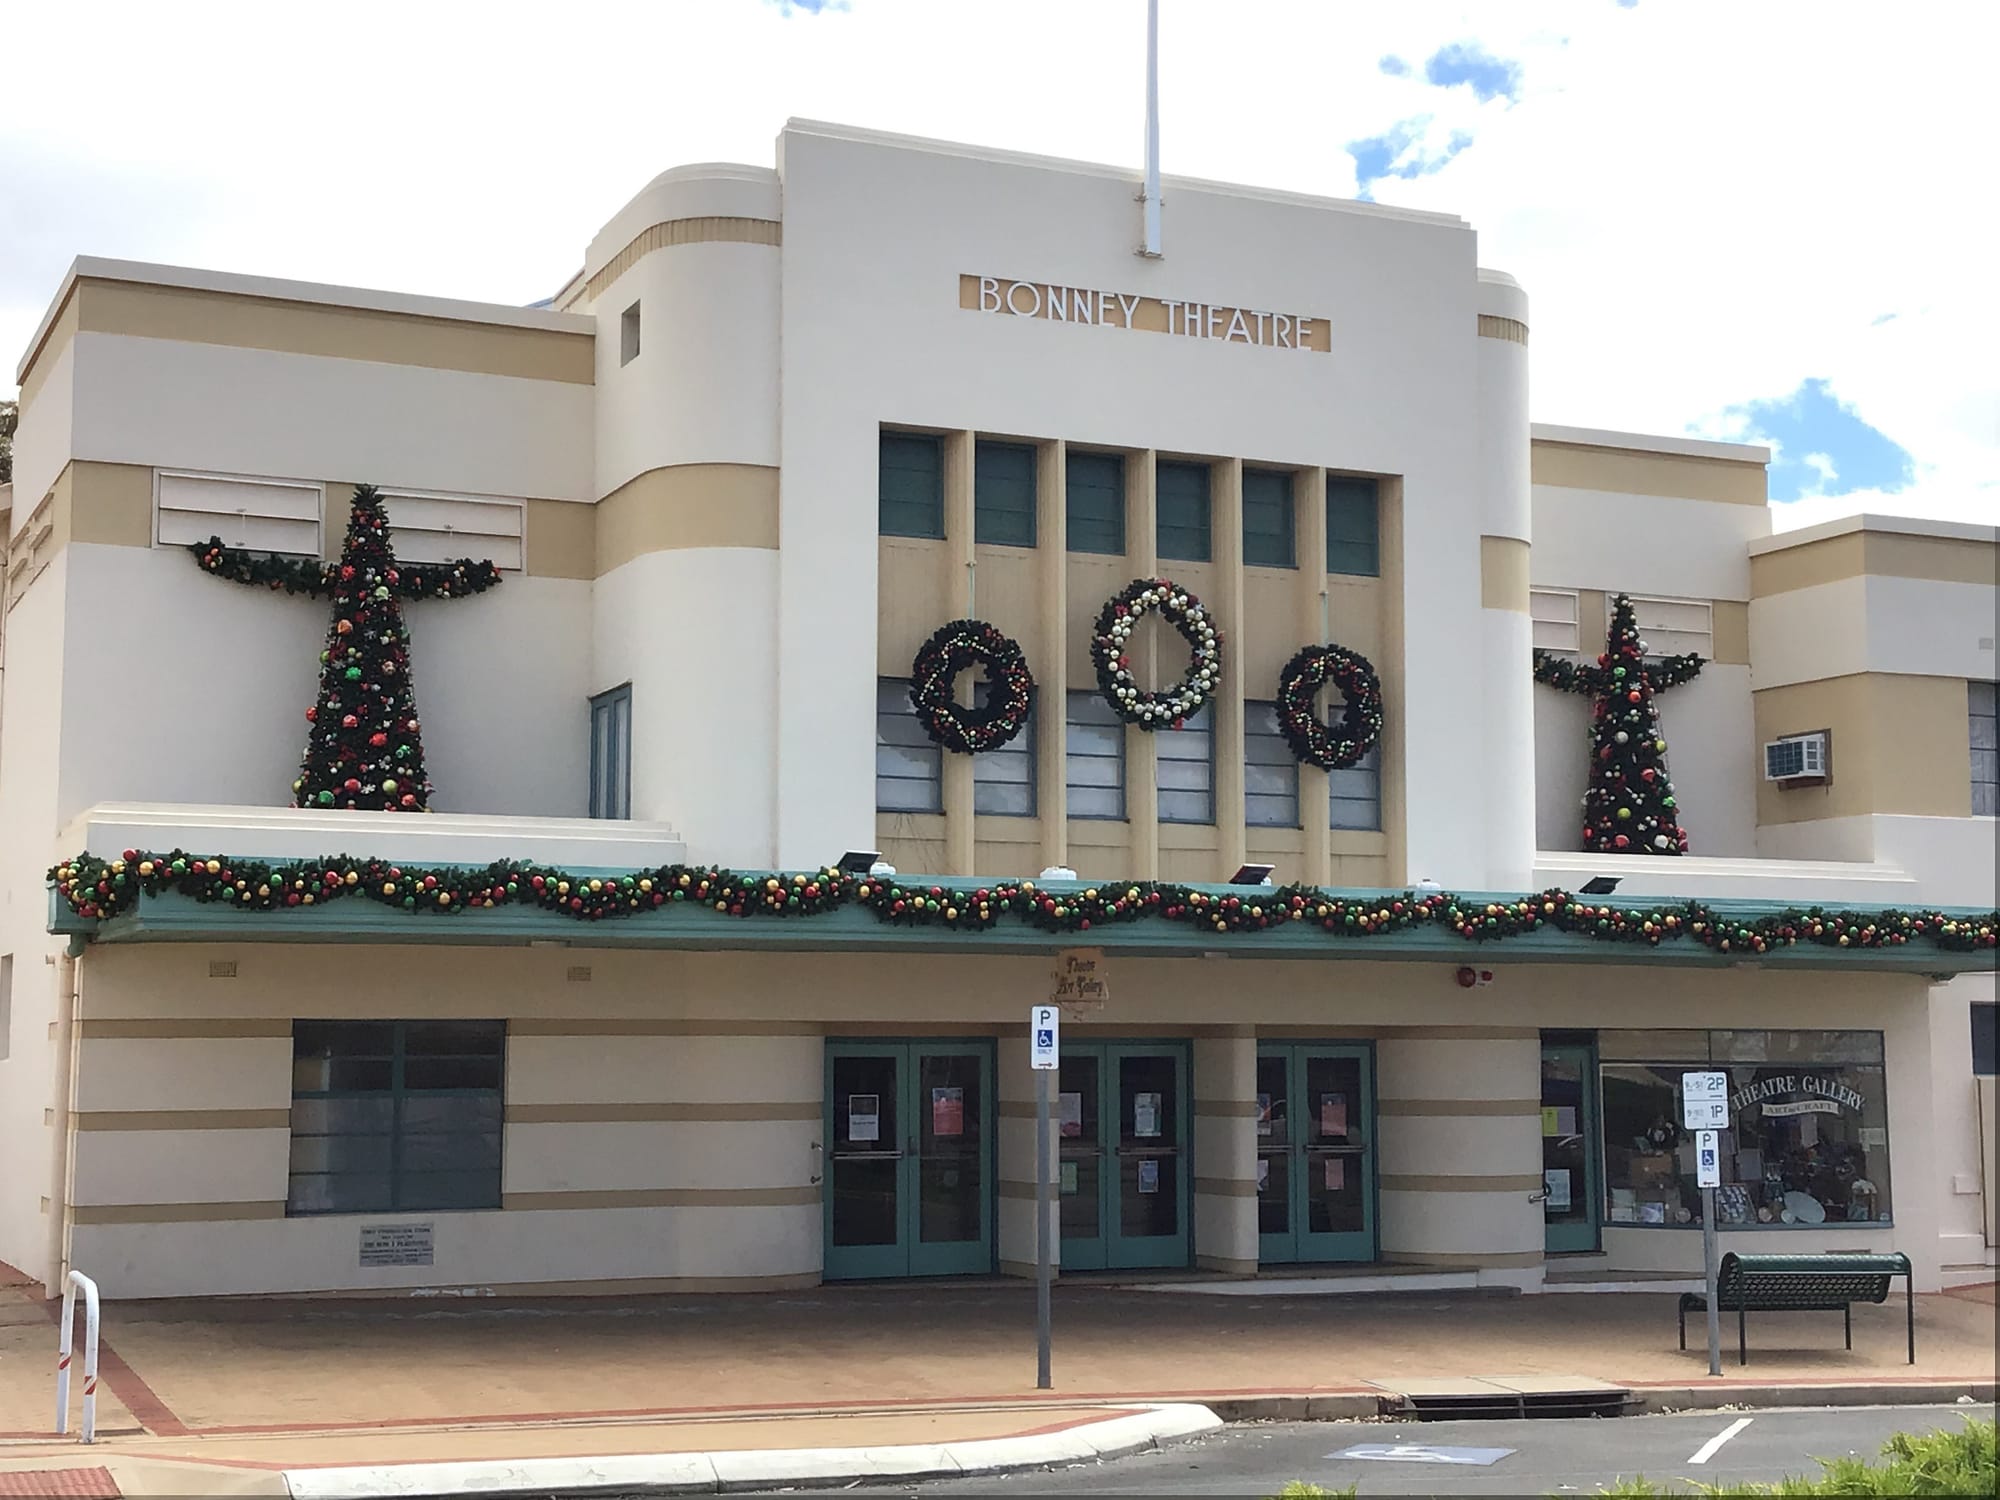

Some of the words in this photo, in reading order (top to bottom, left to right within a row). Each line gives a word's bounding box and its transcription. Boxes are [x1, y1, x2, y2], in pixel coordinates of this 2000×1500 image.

[980, 277, 1141, 329] BONNEY
[1161, 300, 1312, 351] THEATRE
[1040, 1010, 1051, 1026] P
[1707, 1077, 1725, 1091] 2P
[1732, 1075, 1797, 1111] THEATRE
[1802, 1075, 1866, 1111] GALLERY
[1710, 1105, 1724, 1119] 1P
[1767, 1105, 1788, 1114] ART
[1797, 1102, 1833, 1113] CRAFT
[1702, 1133, 1712, 1148] P
